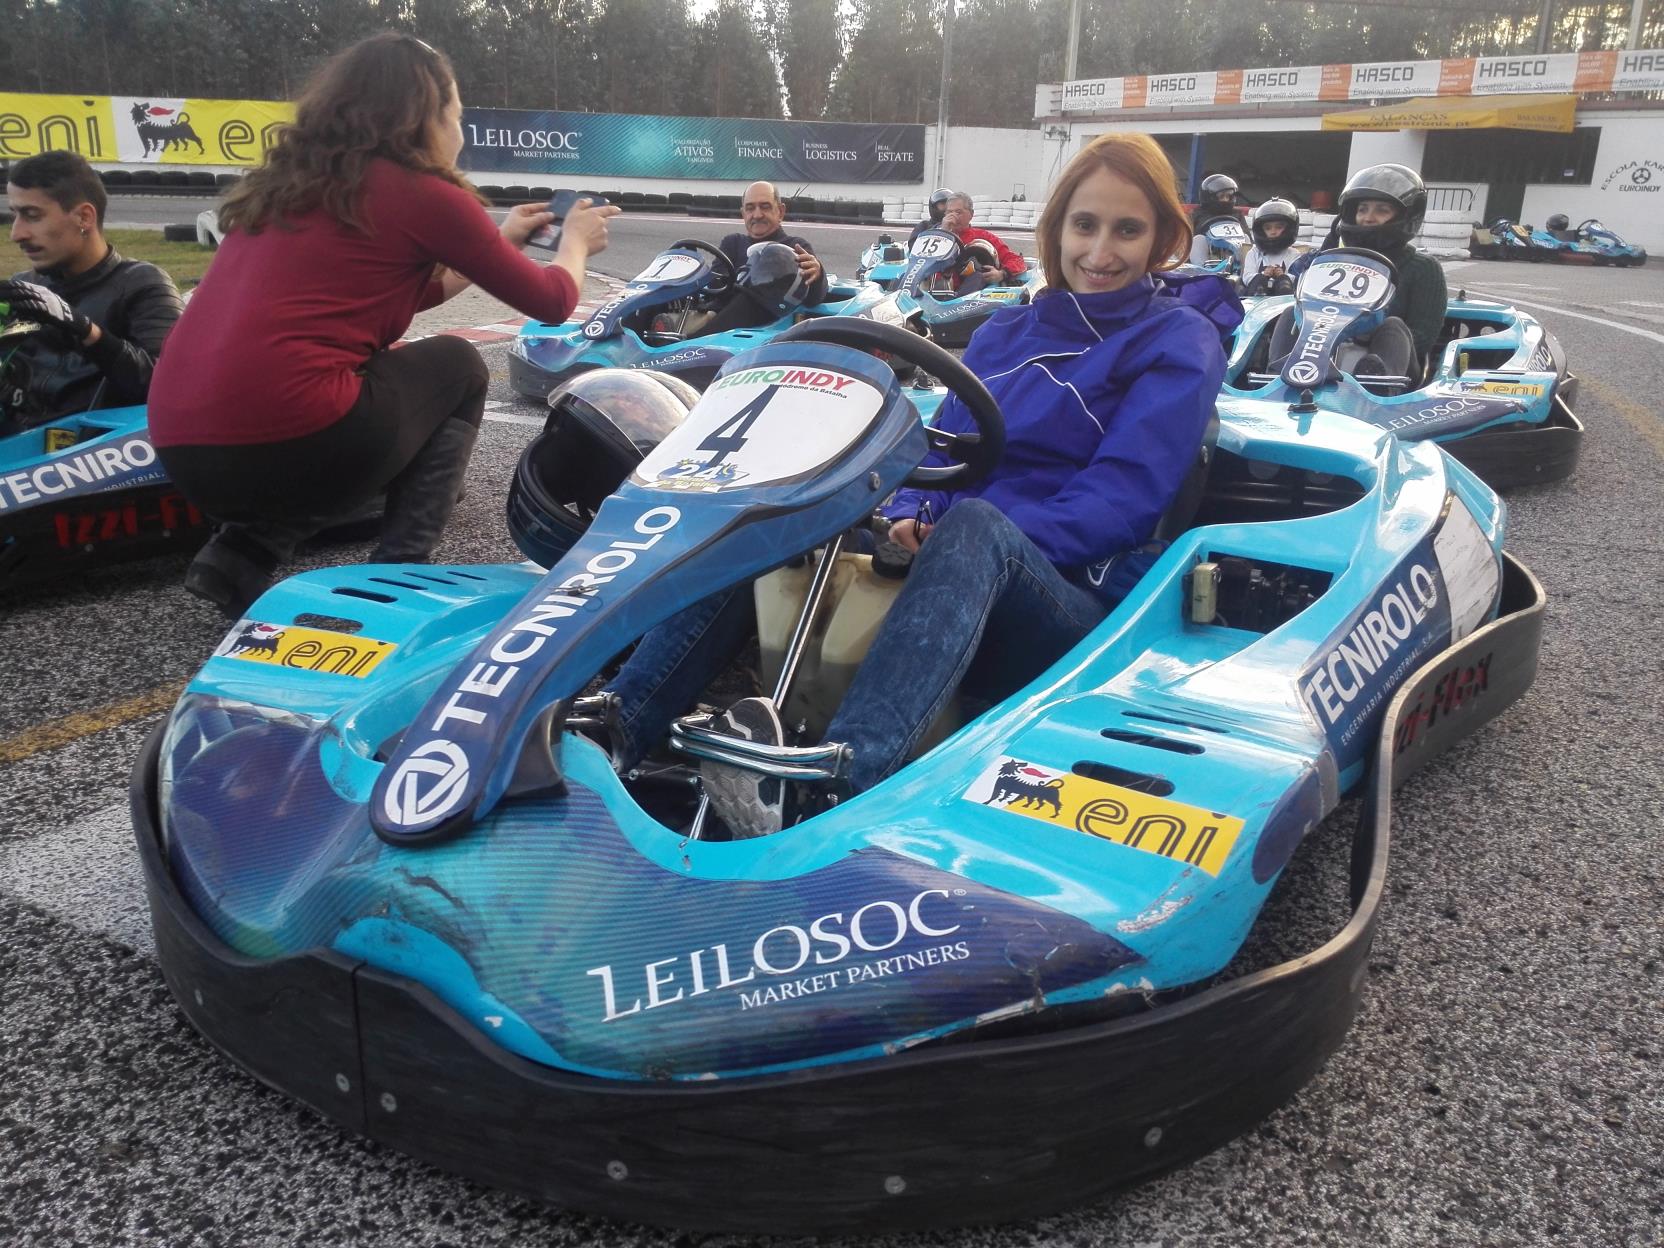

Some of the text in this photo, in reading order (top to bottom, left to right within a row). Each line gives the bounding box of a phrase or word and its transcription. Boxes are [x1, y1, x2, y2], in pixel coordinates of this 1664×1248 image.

[1355, 66, 1414, 82] HASCO
[1479, 60, 1547, 77] HASCO
[1150, 77, 1196, 92] HASCO
[1246, 72, 1298, 87] HASCO
[1065, 83, 1105, 97] HASCO
[0, 100, 102, 158] eni
[468, 124, 579, 150] LEILOSOC
[513, 150, 579, 160] MARKET PARTNERS
[674, 146, 714, 157] ATIVOS
[738, 147, 783, 159] FINANCE
[805, 150, 857, 161] LOGISTICS
[878, 152, 914, 162] ESTATE
[1618, 185, 1661, 193] EUROINDY
[1223, 225, 1240, 235] 31
[921, 238, 942, 254] 15
[652, 260, 673, 278] 1
[1319, 263, 1380, 278] EUROINDY
[1320, 268, 1370, 299] 29
[717, 369, 856, 391] EUROINDY
[820, 389, 848, 399] Batalha
[1492, 384, 1539, 396] eni
[695, 384, 782, 467] 4
[669, 463, 724, 481] 24
[431, 504, 681, 732] TECNIROLO
[1302, 564, 1438, 734] TECNIROLO
[281, 640, 388, 678] eni
[1340, 691, 1384, 747] ENGENHARIA
[1074, 798, 1228, 867] eni
[586, 888, 961, 1023] LEILOSOC
[740, 940, 971, 1011] MARKET PARTNERS
